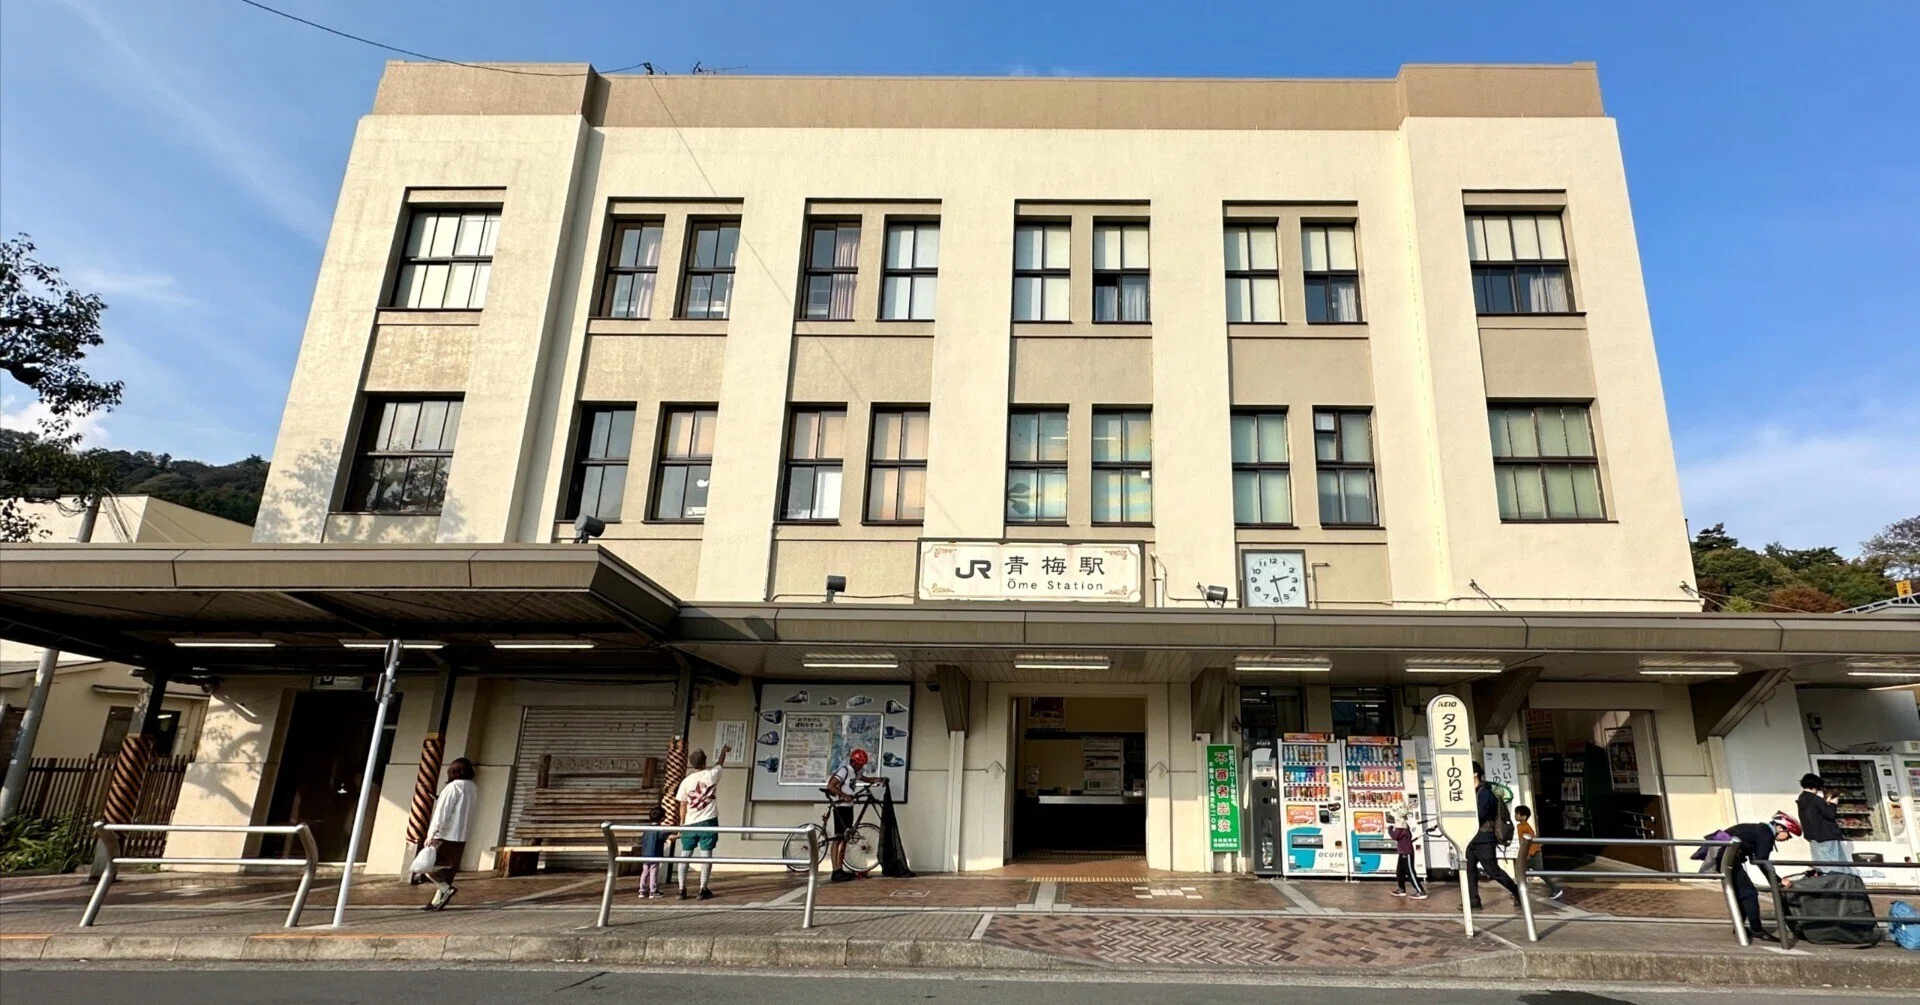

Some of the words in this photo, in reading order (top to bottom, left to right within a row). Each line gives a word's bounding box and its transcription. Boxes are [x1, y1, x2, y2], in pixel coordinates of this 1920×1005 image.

[955, 560, 992, 579] JR
[1004, 555, 1105, 576] 青梅駅
[1007, 578, 1038, 590] Ōme
[1047, 580, 1103, 590] Station
[1442, 713, 1463, 802] タクシーのりば
[1214, 751, 1231, 832] 不審者出没
